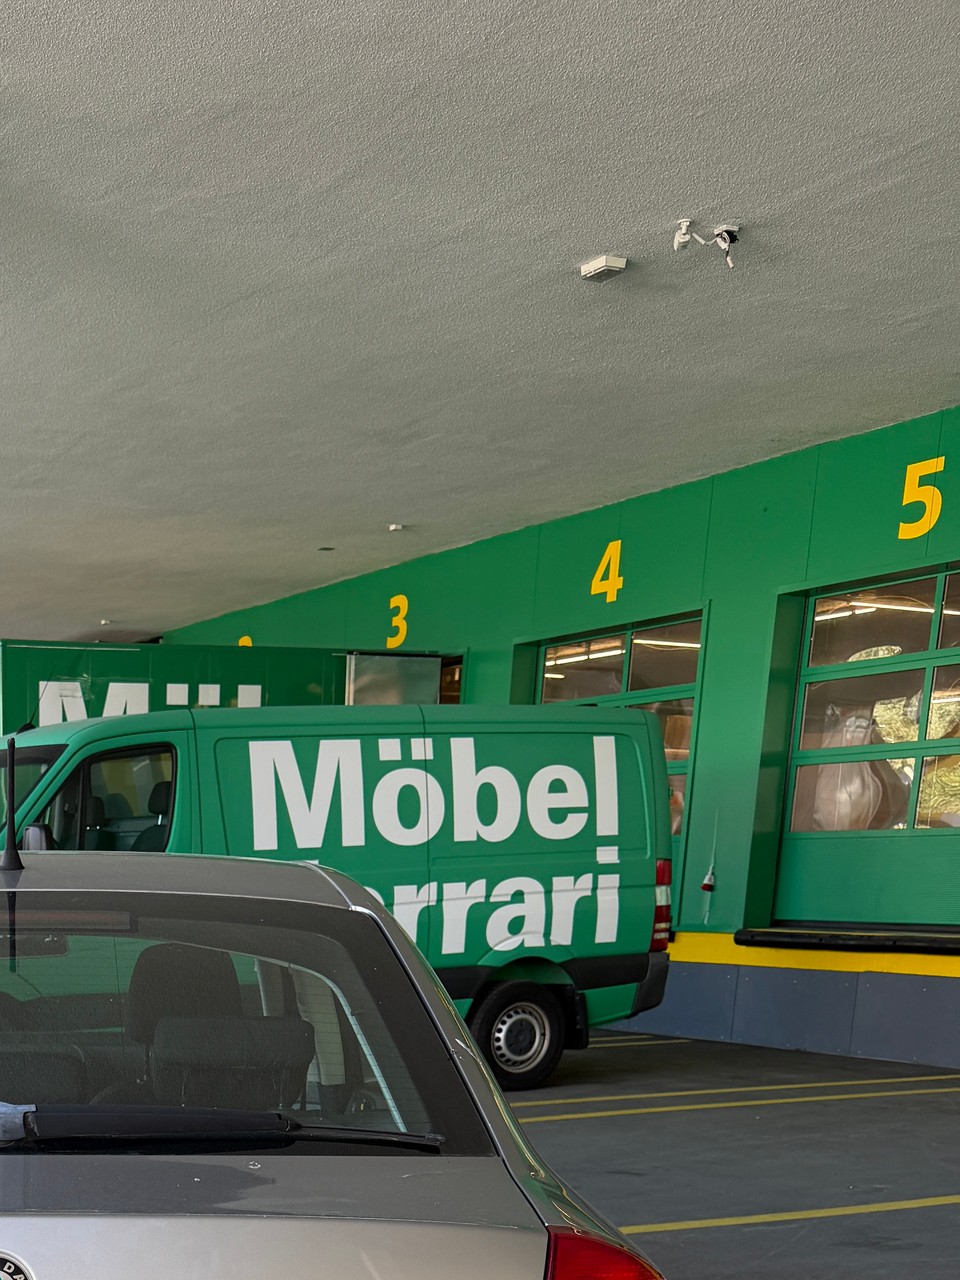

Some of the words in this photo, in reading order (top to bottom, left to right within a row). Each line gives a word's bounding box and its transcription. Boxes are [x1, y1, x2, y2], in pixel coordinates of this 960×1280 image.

[898, 456, 945, 540] 5
[590, 540, 624, 603] 4
[386, 594, 409, 649] 3
[248, 735, 620, 851] Möbel
